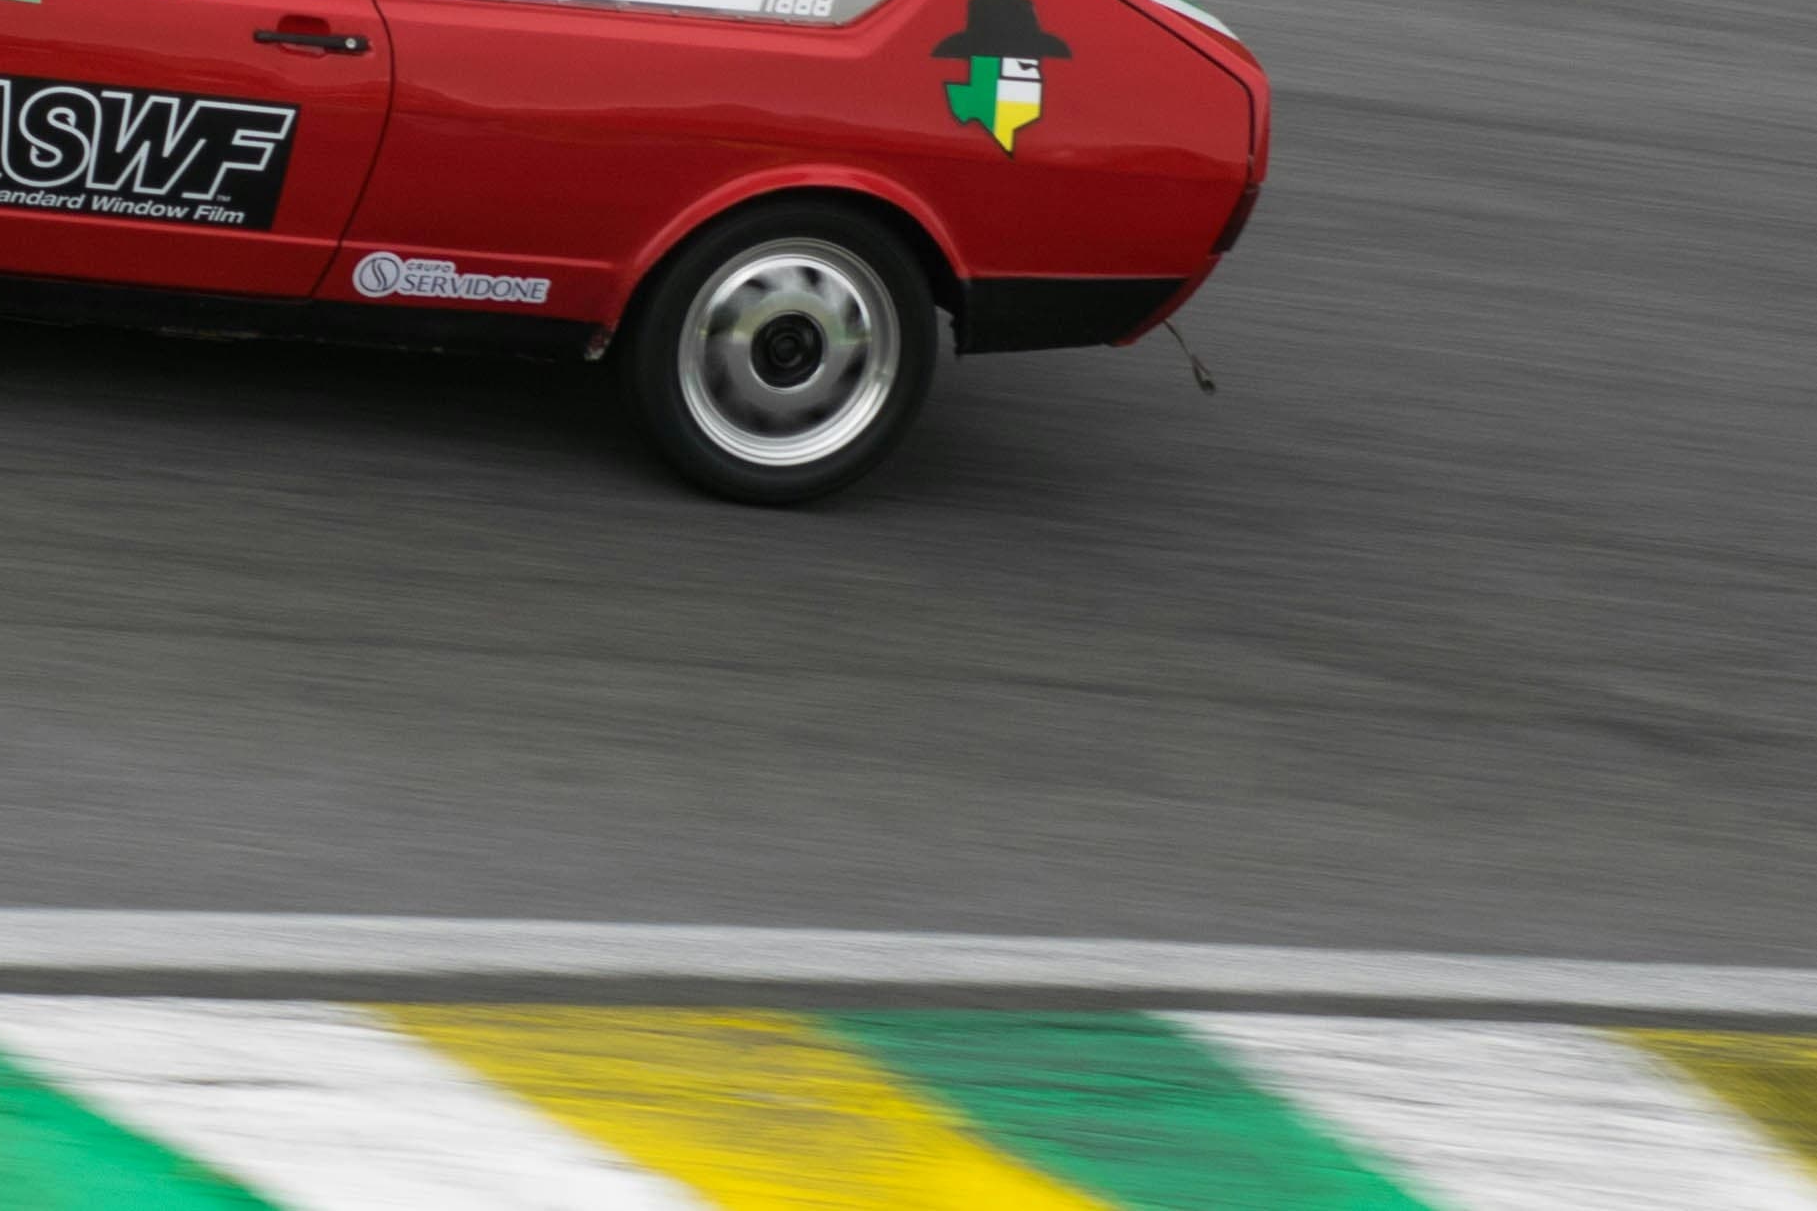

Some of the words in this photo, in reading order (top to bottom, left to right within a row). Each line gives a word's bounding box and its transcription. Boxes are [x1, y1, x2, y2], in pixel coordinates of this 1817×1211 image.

[91, 196, 189, 219] Window
[194, 205, 246, 225] Film
[406, 262, 452, 273] GRUPO
[400, 273, 547, 300] SERVIDONE
